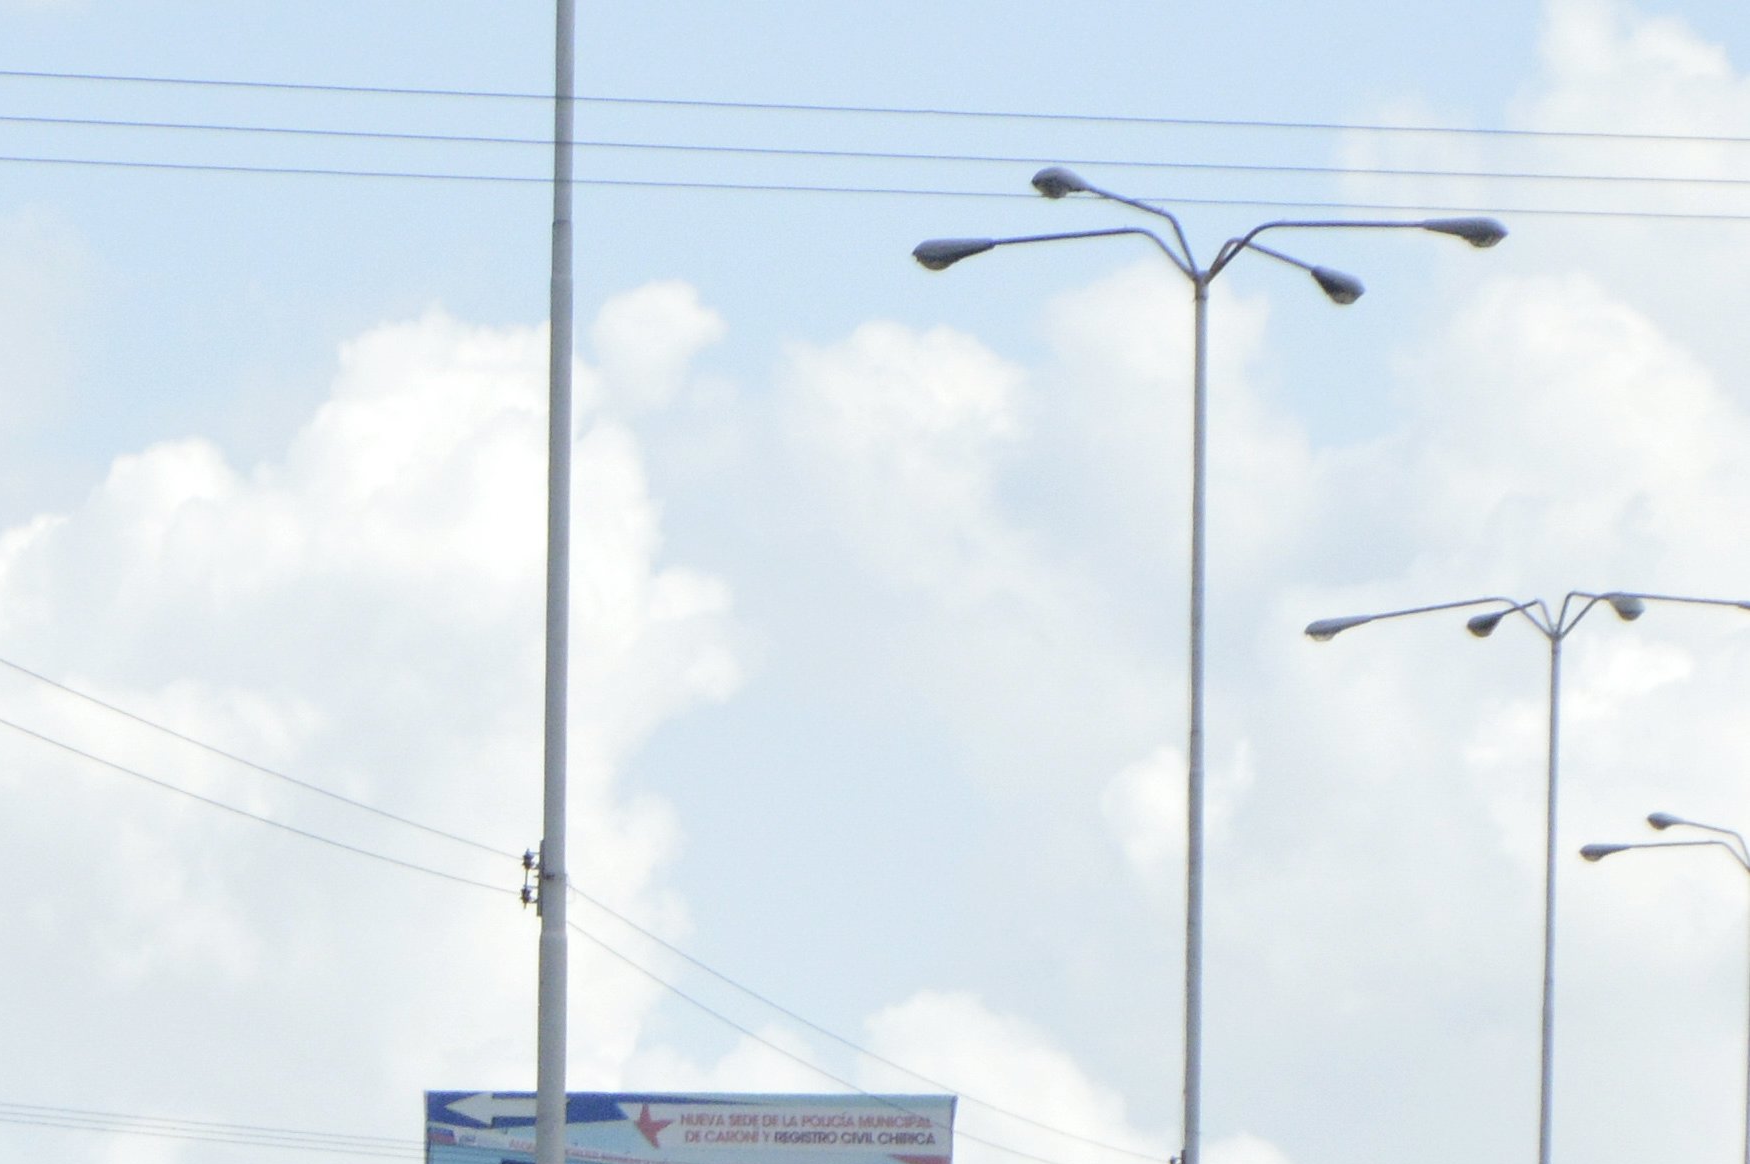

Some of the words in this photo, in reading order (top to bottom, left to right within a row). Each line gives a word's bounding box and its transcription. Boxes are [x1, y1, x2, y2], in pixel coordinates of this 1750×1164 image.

[680, 1113, 725, 1127] NUEVA
[728, 1113, 760, 1128] SEDE
[762, 1114, 779, 1128] DE
[782, 1114, 799, 1128] LA
[858, 1114, 932, 1129] MUNICIPAL
[684, 1130, 701, 1144] DE
[762, 1131, 771, 1143] Y
[773, 1130, 838, 1145] REGISTRO
[840, 1131, 875, 1145] CIVIL
[876, 1131, 936, 1146] CHIRICA
